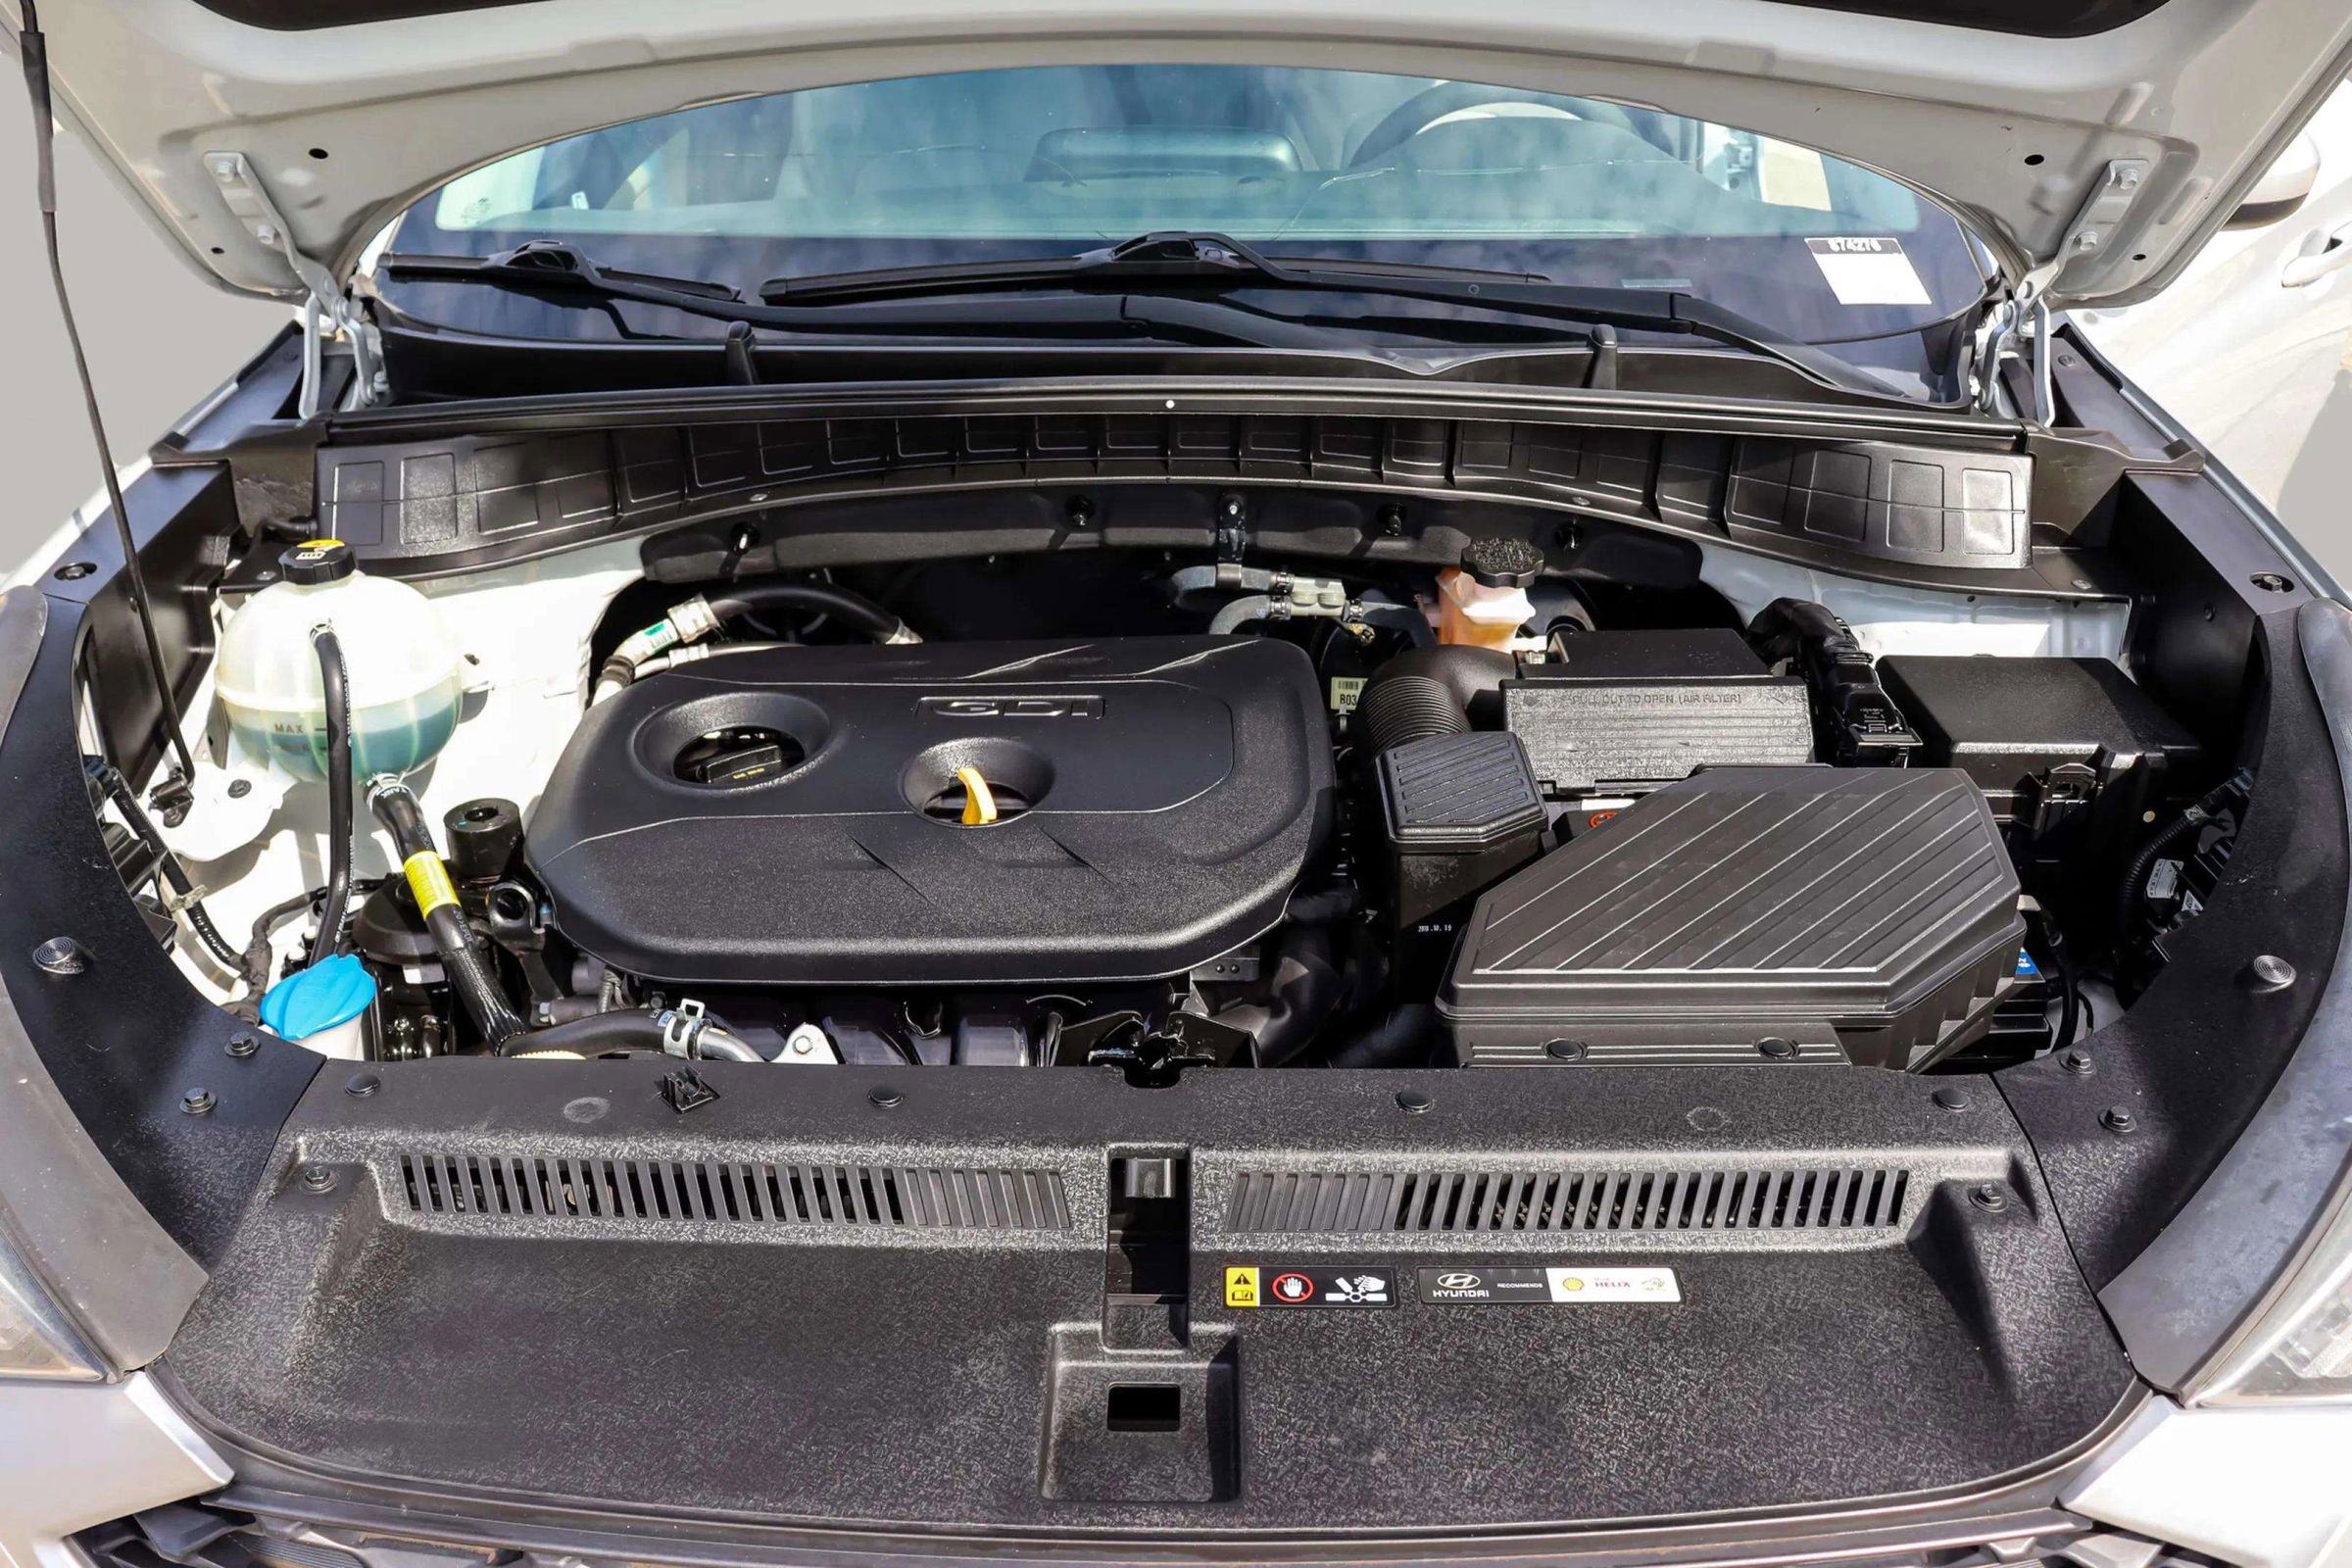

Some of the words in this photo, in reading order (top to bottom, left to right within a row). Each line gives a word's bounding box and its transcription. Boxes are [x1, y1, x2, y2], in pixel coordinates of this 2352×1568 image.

[1570, 694, 1601, 705] PULL
[1626, 694, 1642, 704] TO
[1643, 694, 1674, 704] OPEN
[1678, 694, 1701, 705] (AIR
[933, 701, 1088, 716] GDI
[273, 722, 305, 734] MAX
[1432, 1289, 1491, 1298] HYUNDAI
